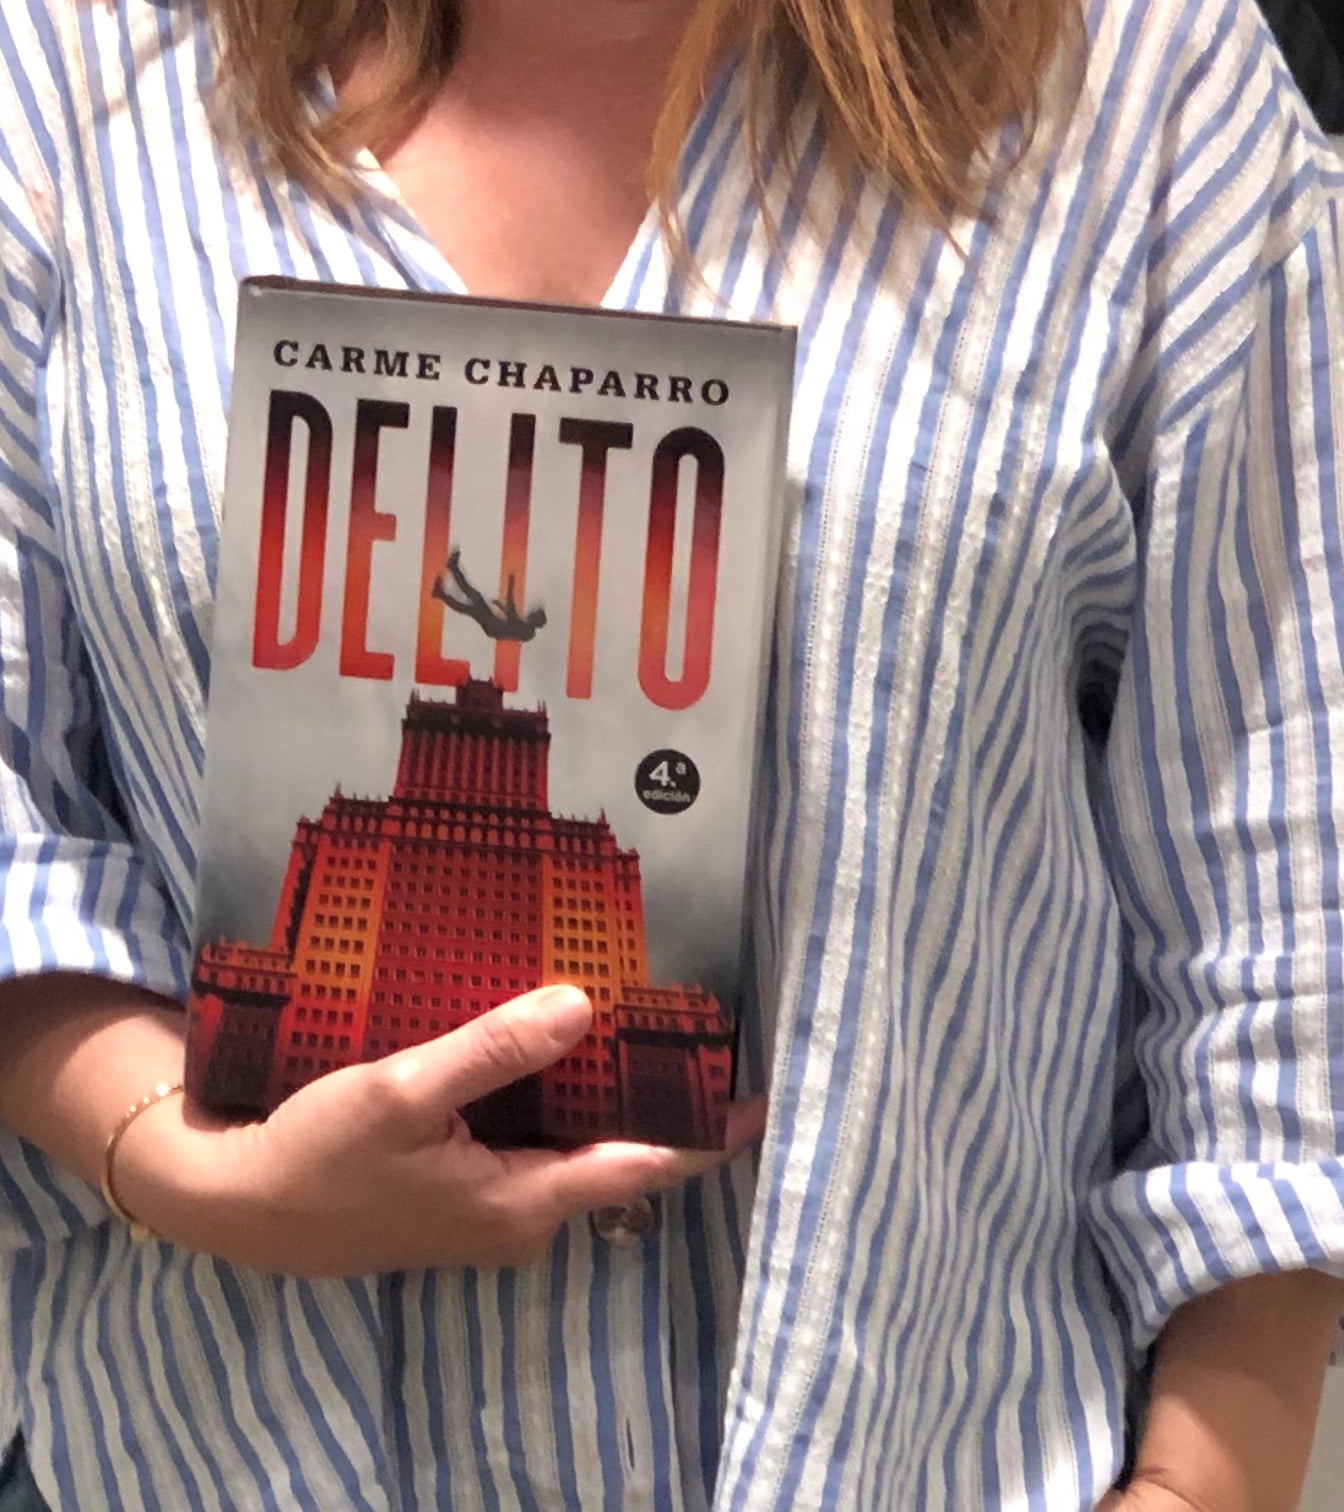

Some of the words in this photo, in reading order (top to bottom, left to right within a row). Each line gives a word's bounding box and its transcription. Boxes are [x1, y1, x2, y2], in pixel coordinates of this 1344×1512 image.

[273, 339, 442, 381] CARME
[464, 357, 730, 406] CHAPARRO
[252, 389, 726, 710] DELITO
